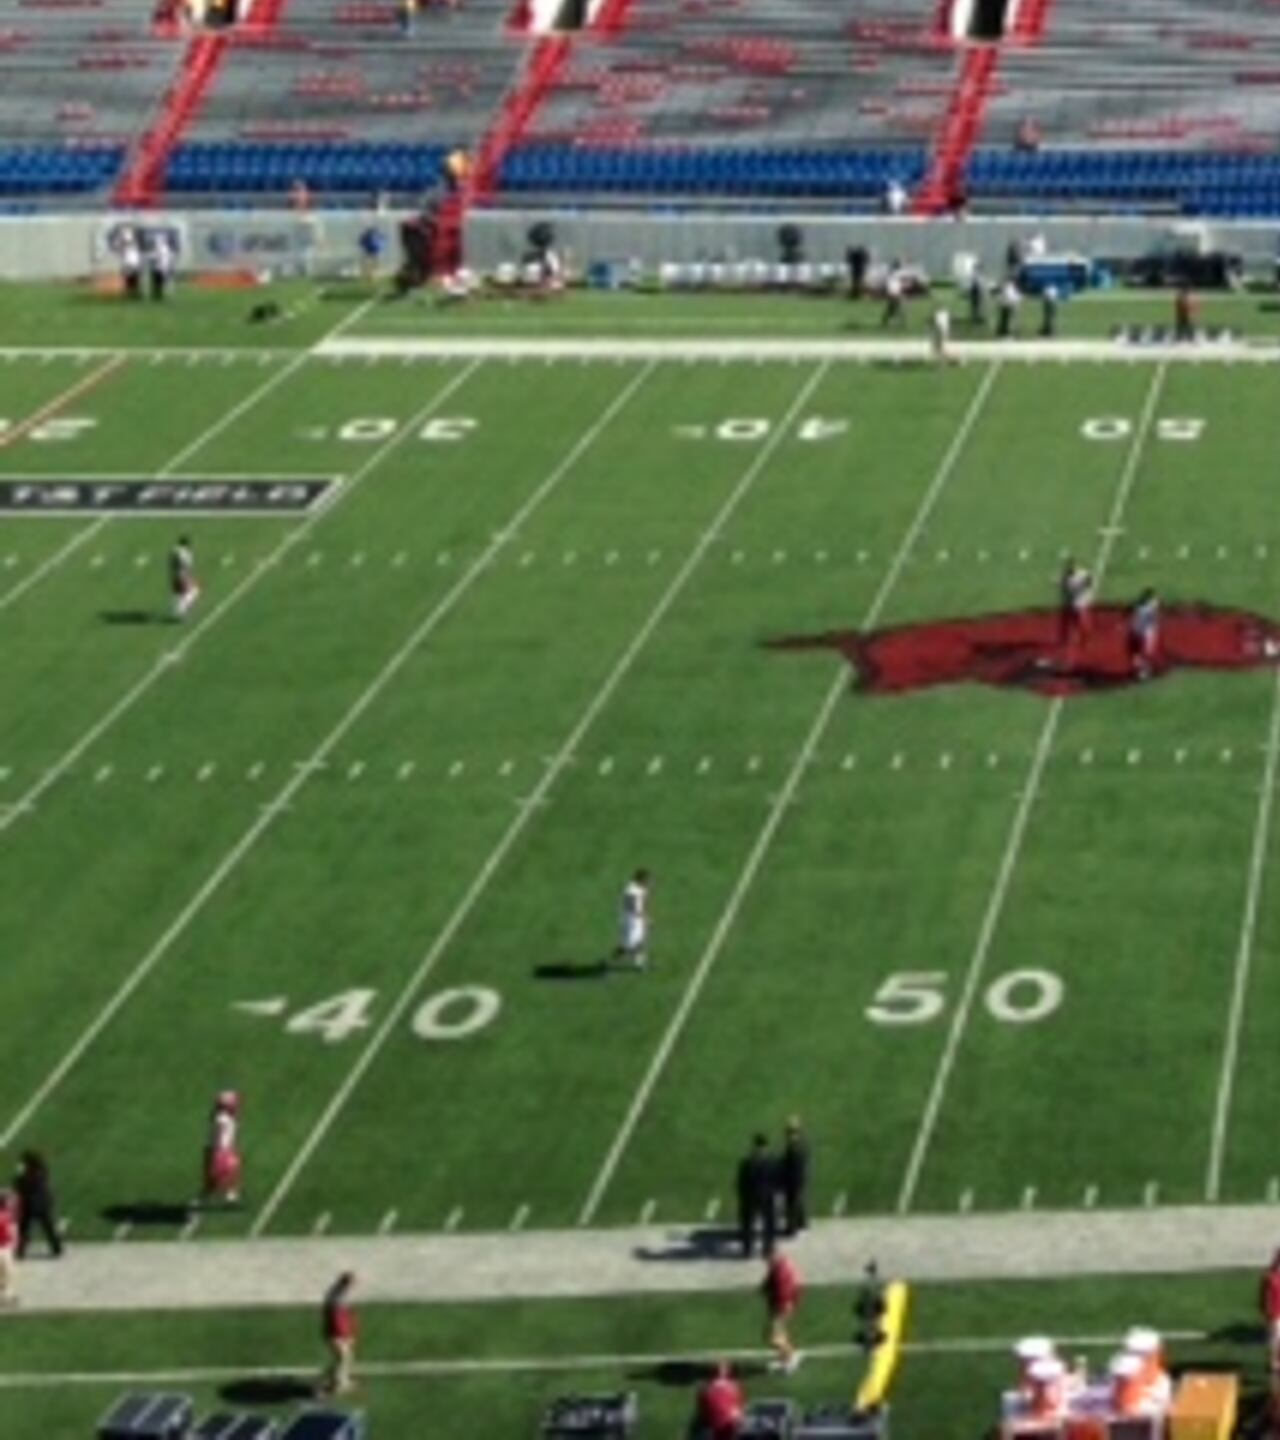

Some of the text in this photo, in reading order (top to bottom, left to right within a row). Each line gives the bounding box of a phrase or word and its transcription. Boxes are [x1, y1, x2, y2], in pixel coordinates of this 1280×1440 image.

[336, 417, 477, 442] 30
[713, 416, 849, 442] 40
[1078, 416, 1207, 442] 50
[865, 969, 1064, 1024] 50
[287, 987, 502, 1040] 40
